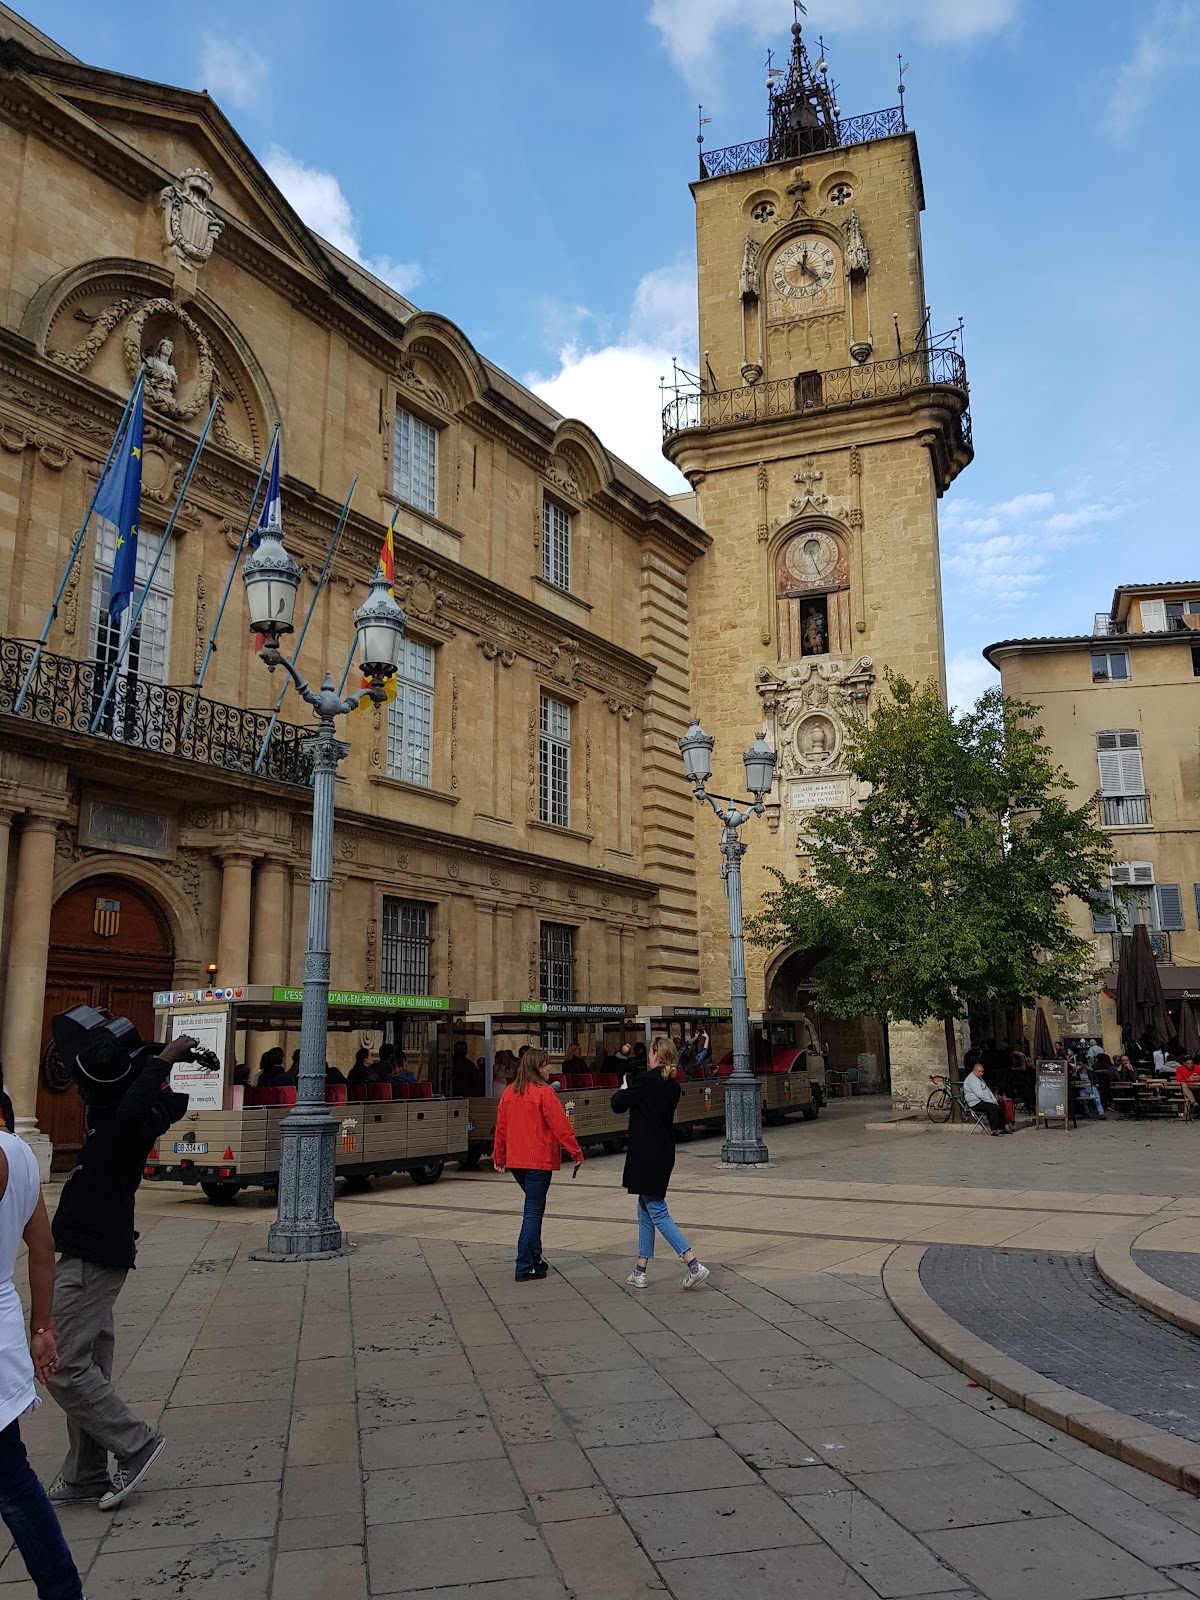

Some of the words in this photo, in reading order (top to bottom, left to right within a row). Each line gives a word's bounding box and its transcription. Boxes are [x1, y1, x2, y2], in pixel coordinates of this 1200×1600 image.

[105, 824, 118, 833] DE
[284, 990, 304, 1000] L'ESS
[329, 993, 396, 1005] D'AIX-EN-PROVENCE
[397, 998, 406, 1006] EN
[407, 998, 415, 1006] 40
[416, 999, 443, 1008] MINUTES
[523, 1003, 541, 1011] DÉPART
[548, 1004, 562, 1012] OFFICE
[567, 1005, 586, 1013] TOURISME
